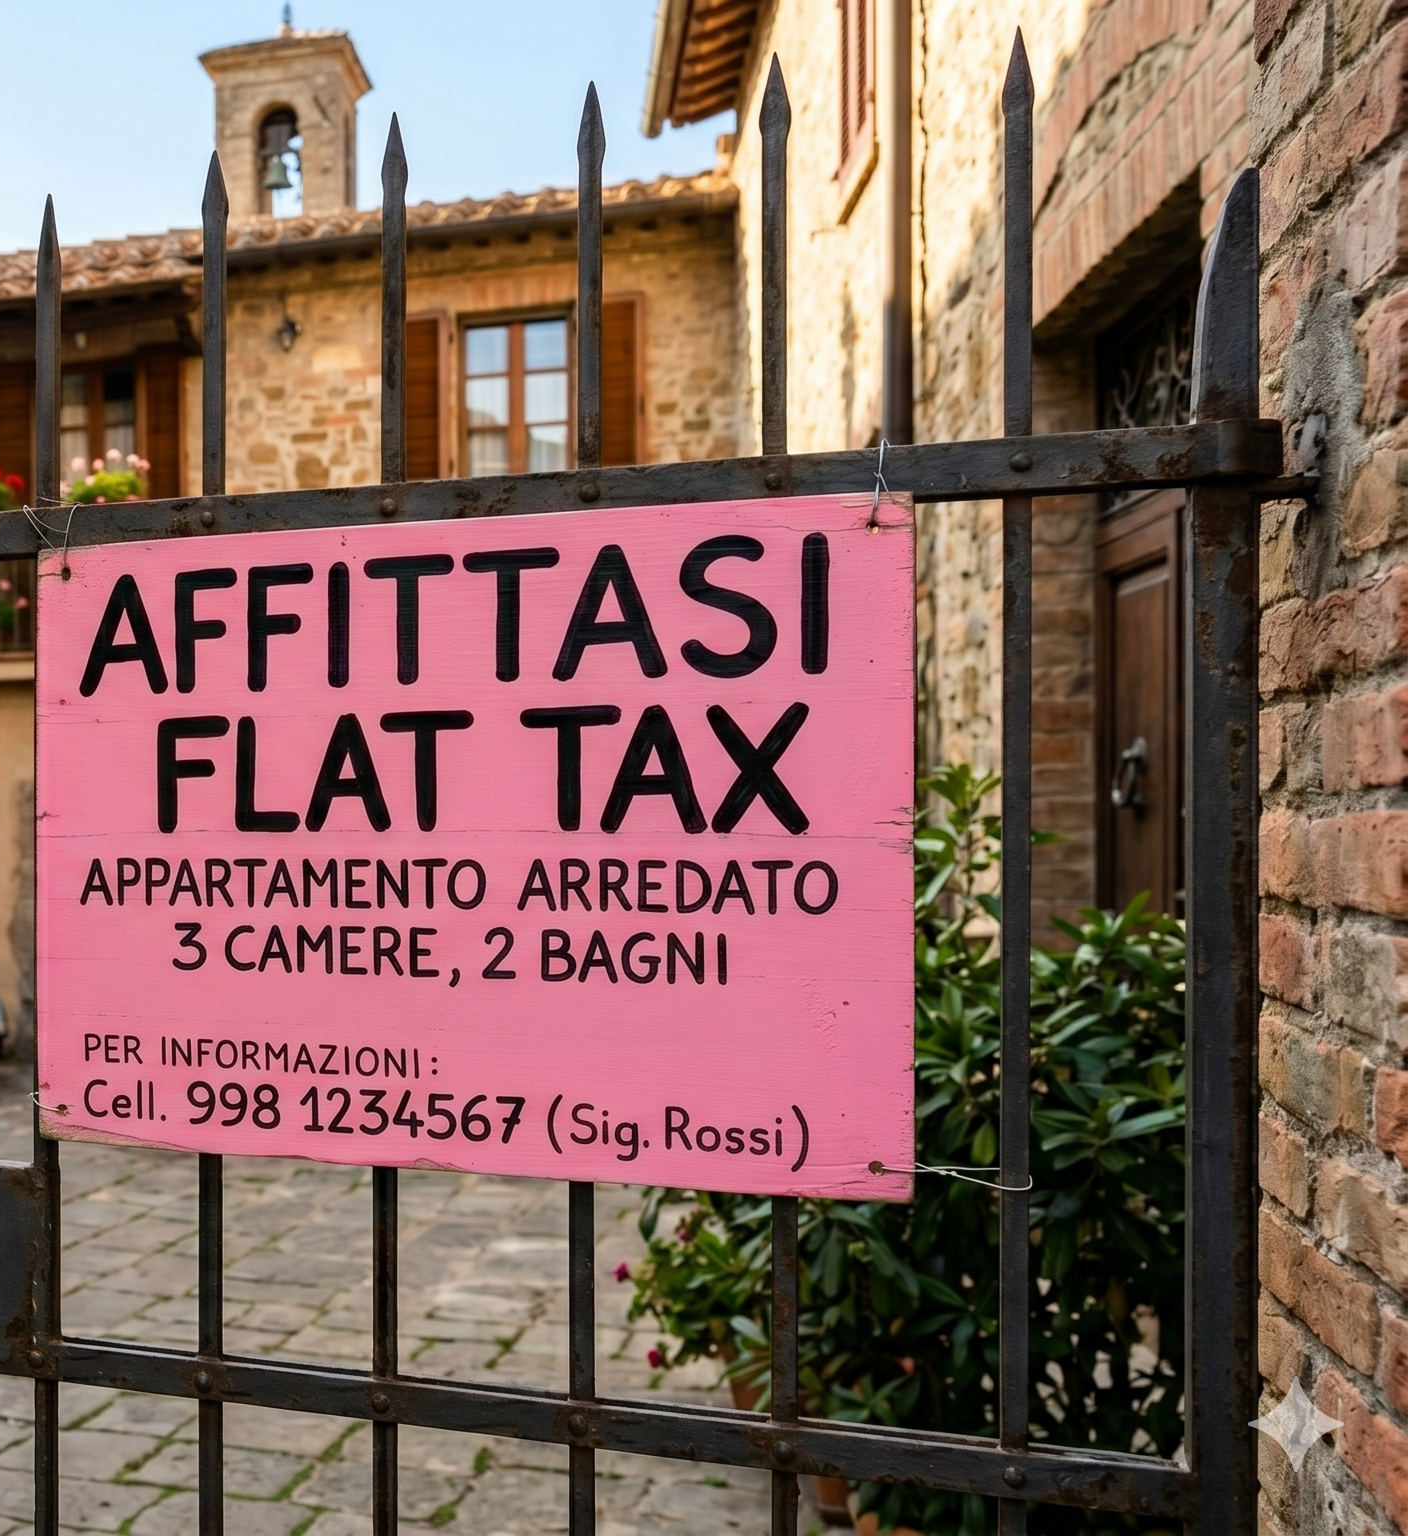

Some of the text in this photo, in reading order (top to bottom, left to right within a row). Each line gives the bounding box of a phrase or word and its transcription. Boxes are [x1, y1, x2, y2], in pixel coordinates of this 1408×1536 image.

[79, 531, 831, 698] AFFITTASI
[156, 701, 810, 836] FLAT TAX
[79, 857, 839, 916] APPARTAMENTO ARREDATO
[172, 922, 728, 988] 3 CAMERE, 2 BAGNI
[84, 1033, 440, 1079] PER INFORMAZIONI:
[83, 1079, 809, 1173] Cell. 998 1234567 (Sig. Rossi)
